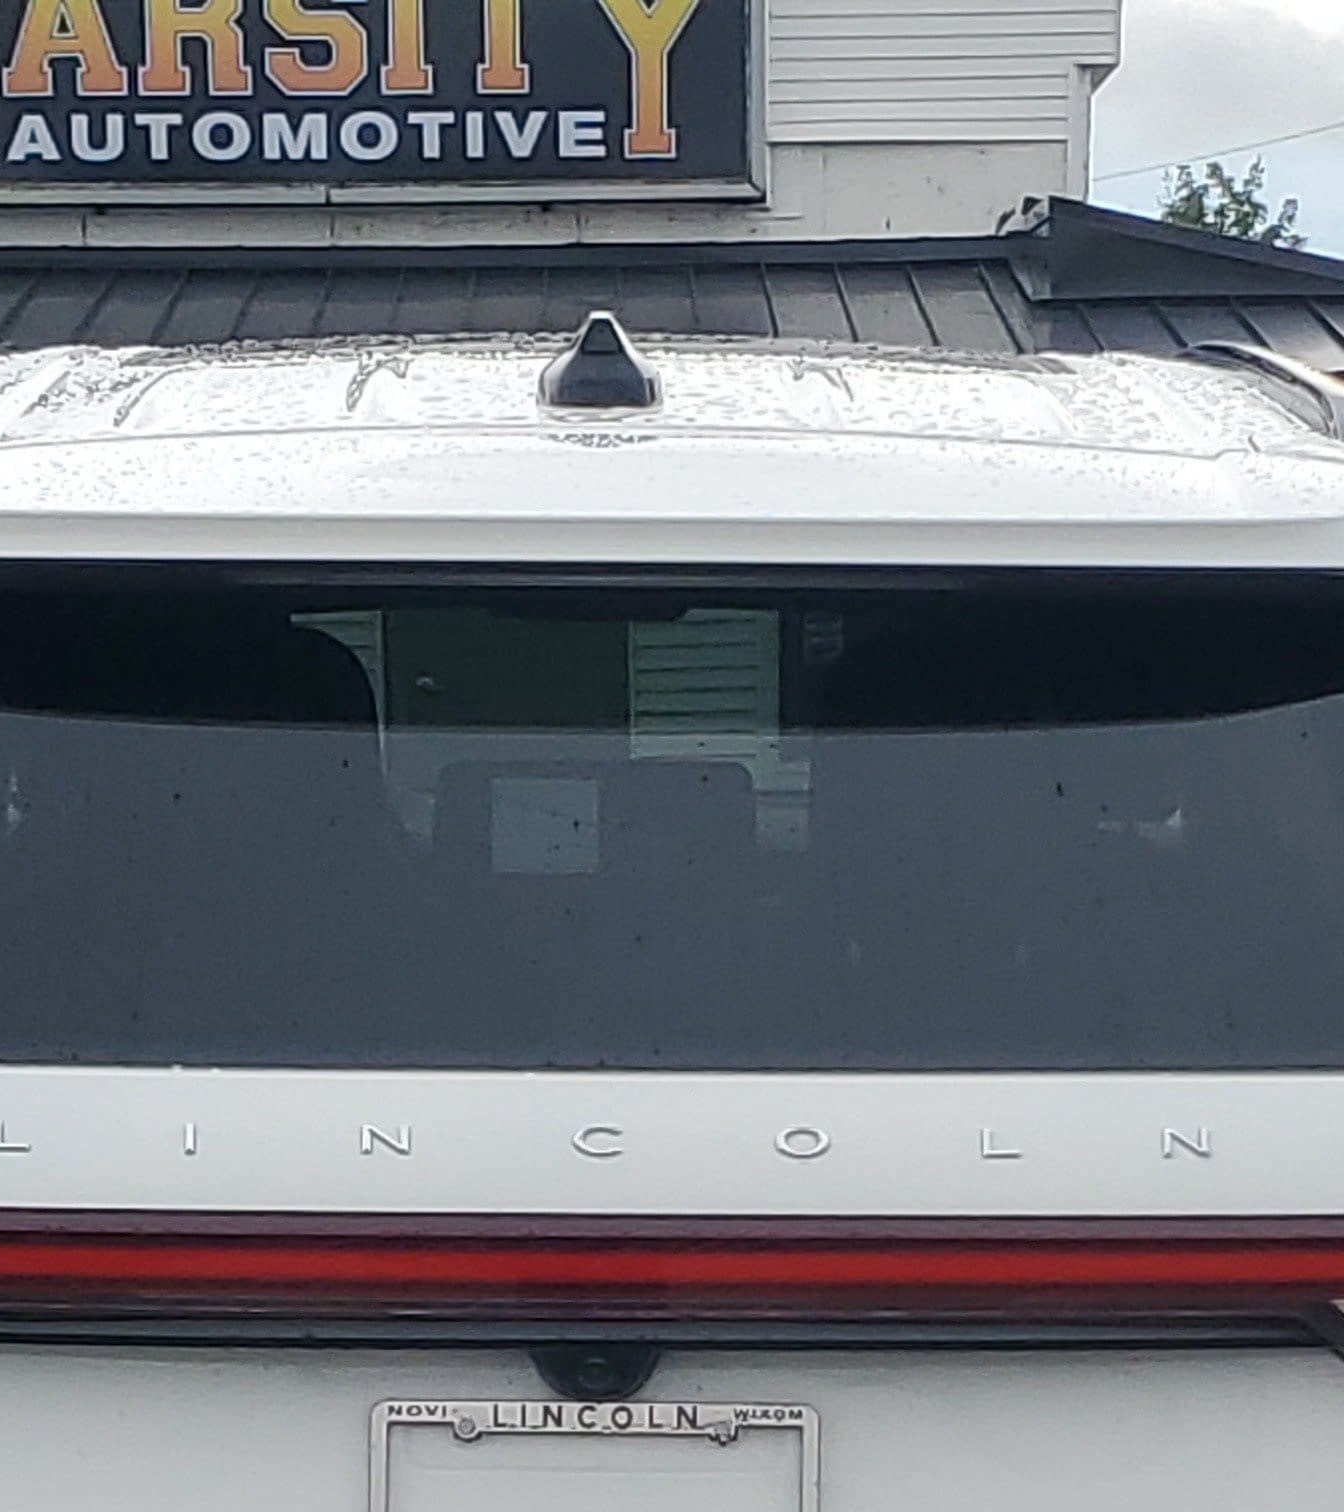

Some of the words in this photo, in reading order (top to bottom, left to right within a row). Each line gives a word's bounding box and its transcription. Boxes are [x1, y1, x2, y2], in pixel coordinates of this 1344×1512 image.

[6, 111, 607, 161] AUTOMOTIVE
[387, 1405, 447, 1418] NOVI
[493, 1403, 698, 1430] LINCOLN
[733, 1407, 804, 1421] WIXOM
